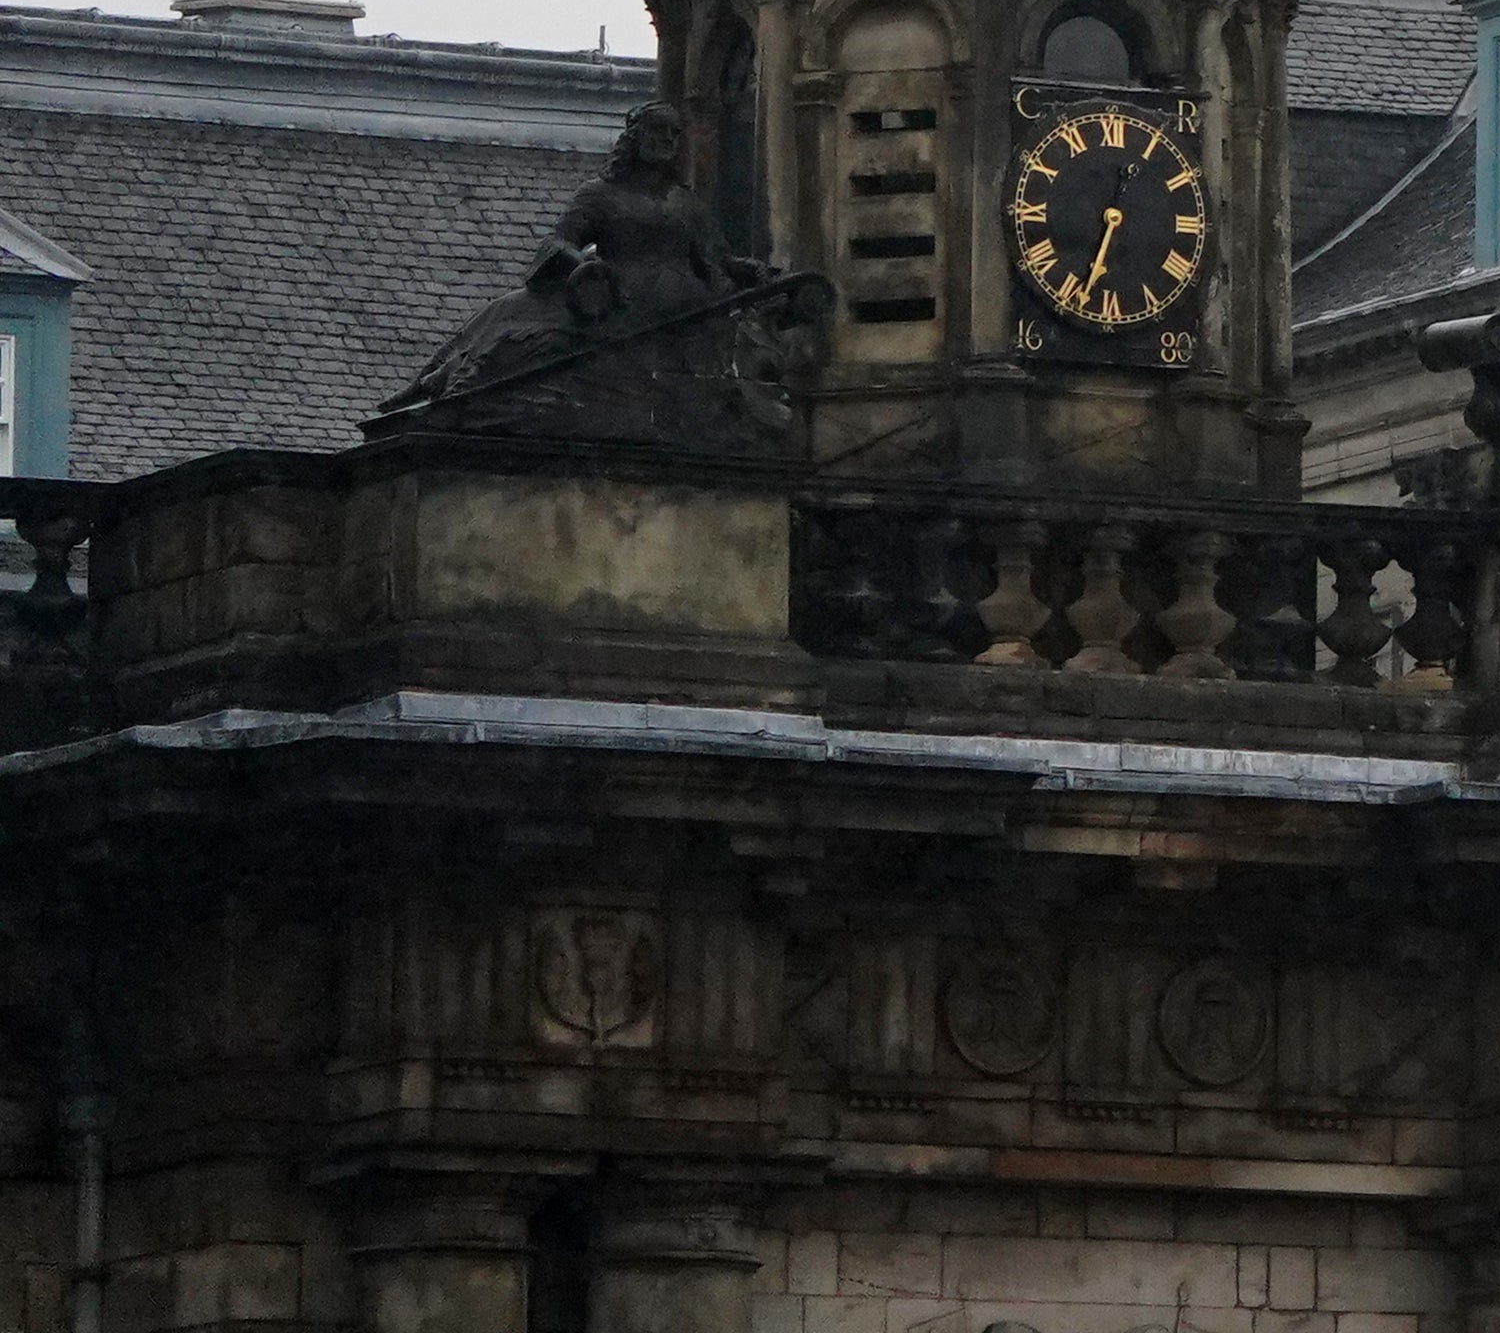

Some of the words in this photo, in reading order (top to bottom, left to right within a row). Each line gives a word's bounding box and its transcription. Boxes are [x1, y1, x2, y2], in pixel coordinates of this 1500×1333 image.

[1016, 86, 1041, 120] C
[1177, 99, 1197, 133] R
[1060, 127, 1088, 159] XI
[1099, 118, 1126, 149] XII
[1141, 136, 1161, 161] I
[1029, 157, 1060, 184] X
[1165, 170, 1193, 192] II
[1017, 200, 1047, 224] IX
[1175, 214, 1201, 235] III
[1027, 238, 1059, 277] VIII
[1161, 247, 1193, 282] IIII
[1102, 288, 1122, 319] VI
[1142, 283, 1161, 312] V
[1016, 318, 1043, 351] 16
[1161, 332, 1193, 363] 80
